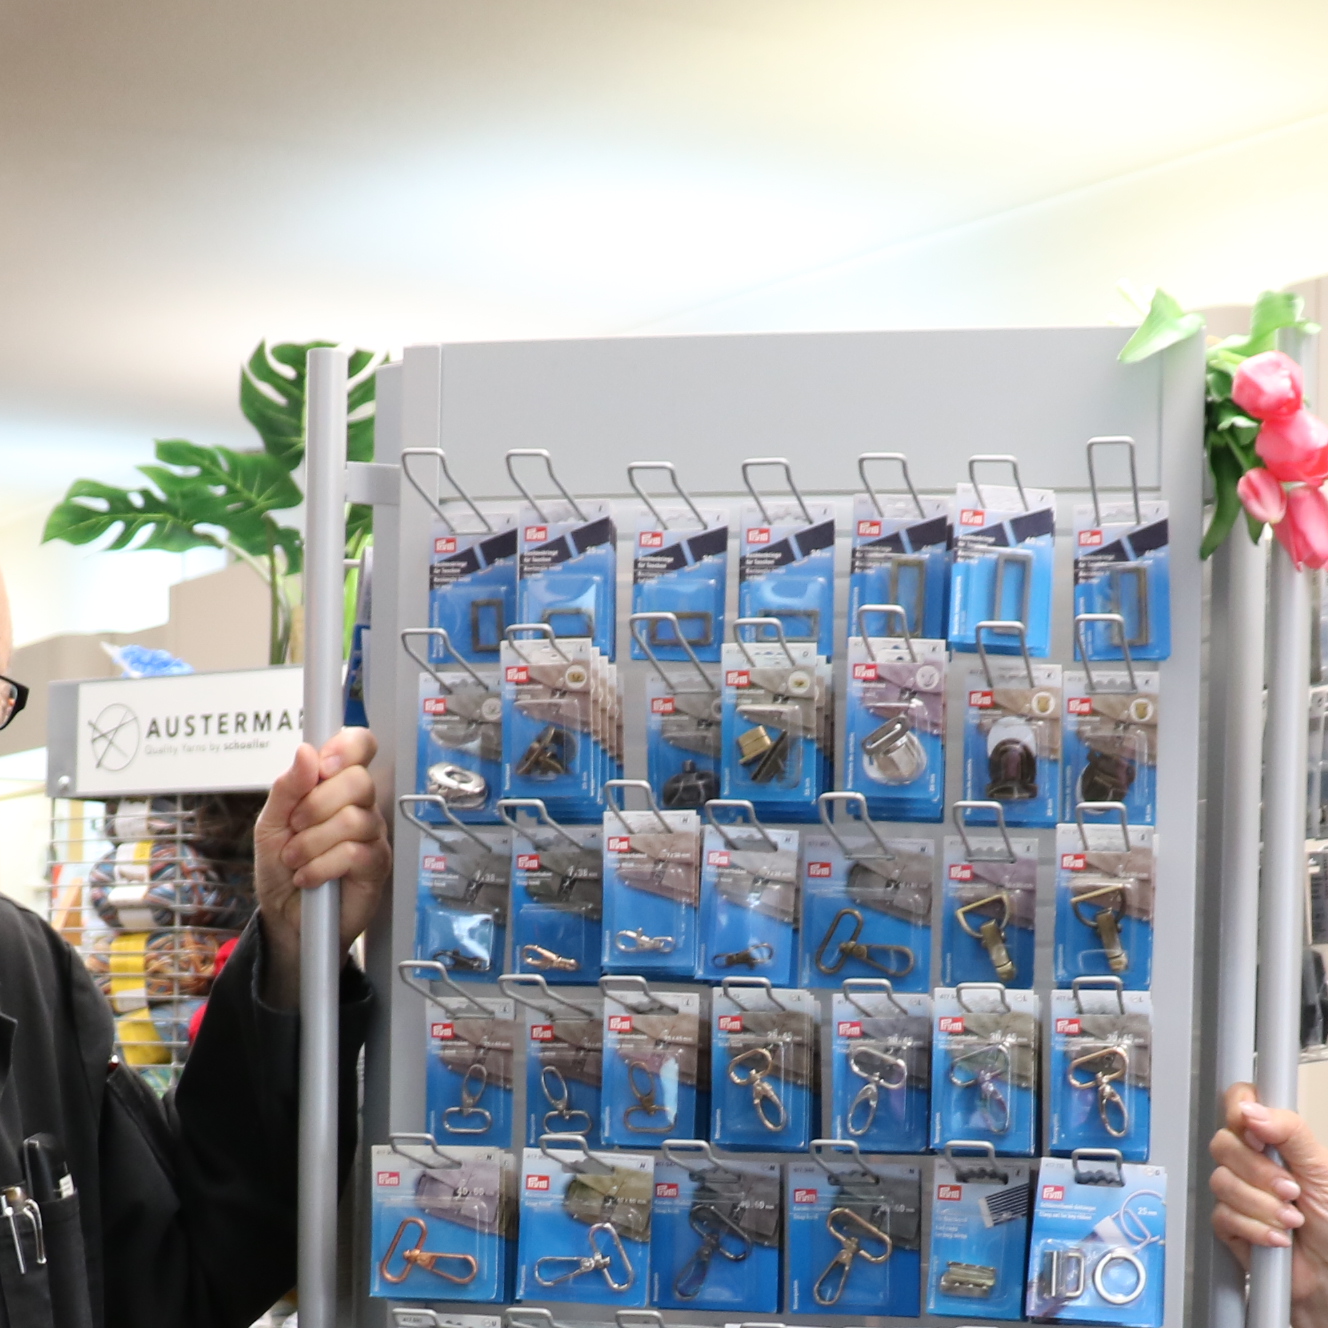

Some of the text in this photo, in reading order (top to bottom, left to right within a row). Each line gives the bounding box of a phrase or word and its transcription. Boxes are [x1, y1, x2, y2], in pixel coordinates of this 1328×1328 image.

[962, 510, 984, 526] Prym
[526, 526, 546, 540] Prym
[748, 528, 770, 542] Prym
[860, 522, 880, 536] Prym
[436, 538, 456, 552] Prym
[642, 532, 662, 546] Prym
[1080, 530, 1102, 546] Prym
[506, 666, 532, 684] Prym
[728, 670, 750, 688] Prym
[854, 664, 878, 680] Prym
[426, 698, 446, 714] Prym
[970, 692, 996, 708] Prym
[1068, 698, 1094, 714] Prym
[610, 838, 632, 852] Prym
[518, 854, 540, 870] Prym
[1062, 854, 1088, 870] Prym
[952, 866, 974, 880] Prym
[720, 1016, 744, 1030] Prym
[840, 1022, 862, 1036] Prym
[940, 1018, 964, 1032] Prym
[1058, 1018, 1082, 1034] Prym
[432, 1024, 456, 1040] Prym
[532, 1026, 554, 1040] Prym
[528, 1176, 550, 1190] Prym
[938, 1186, 962, 1200] Prym
[1046, 1186, 1064, 1198] Prym
